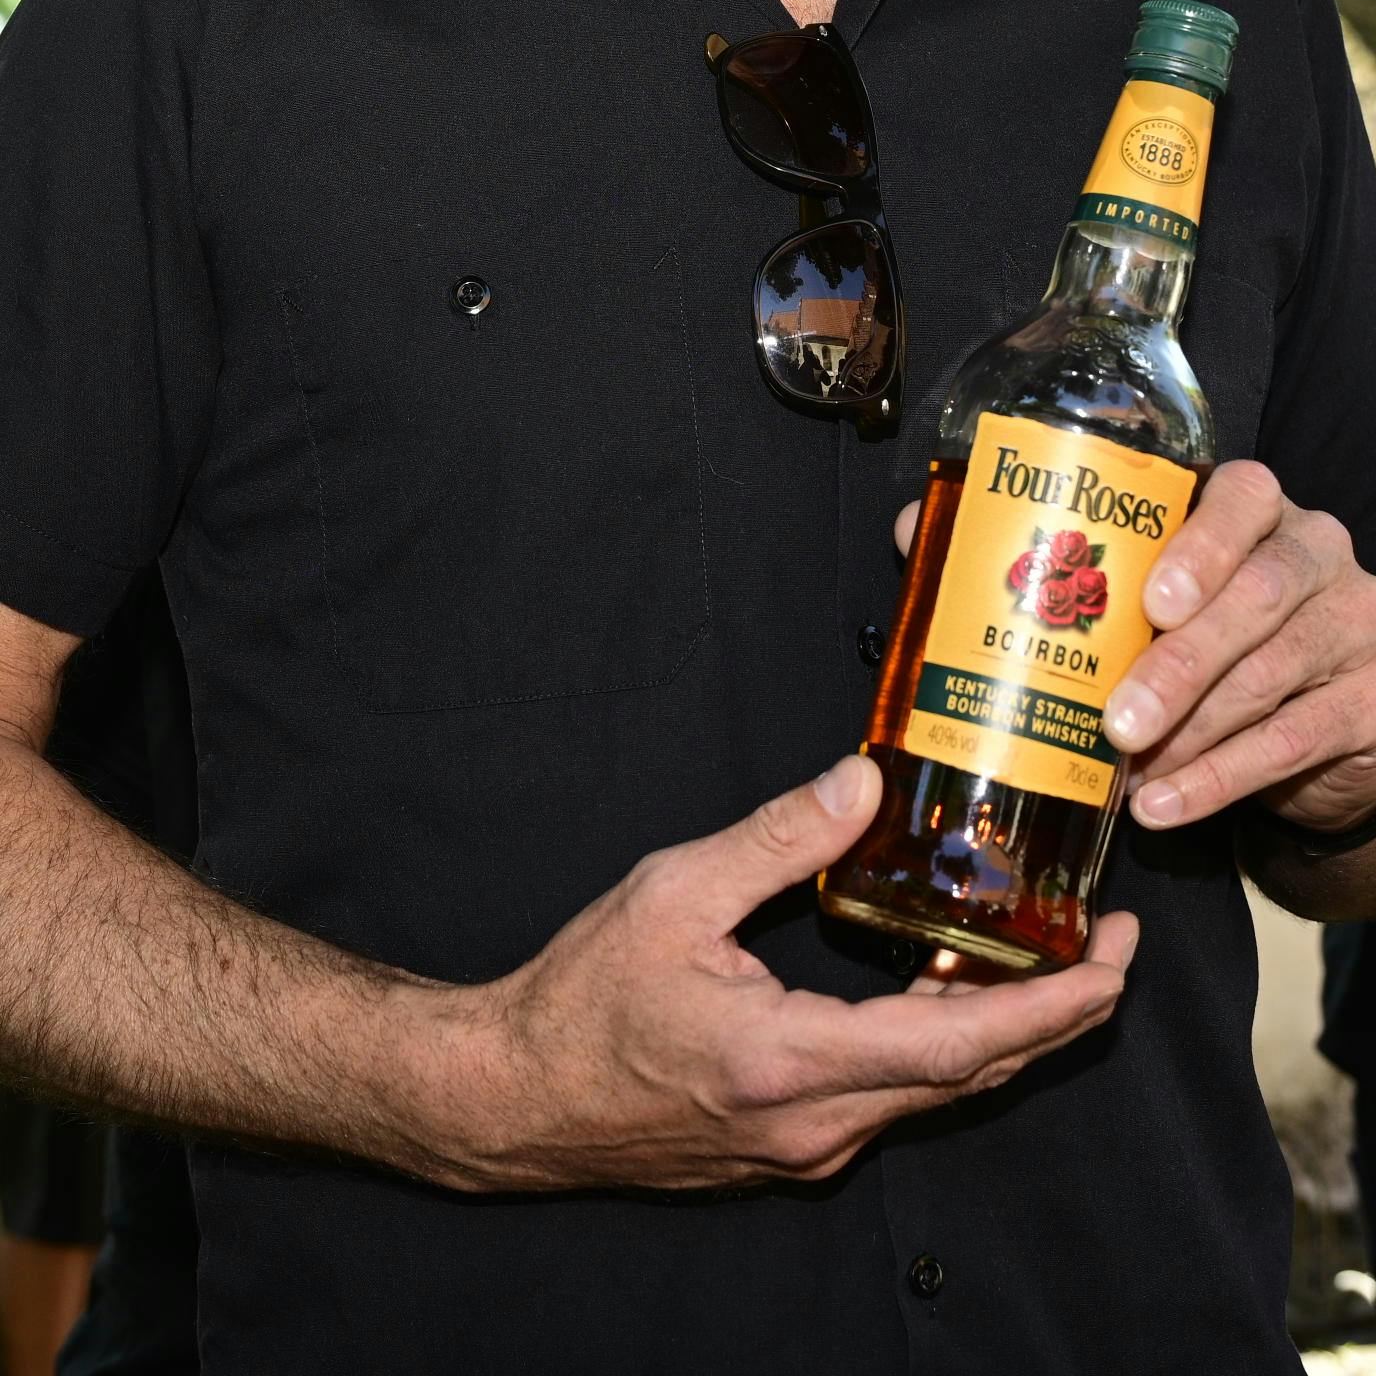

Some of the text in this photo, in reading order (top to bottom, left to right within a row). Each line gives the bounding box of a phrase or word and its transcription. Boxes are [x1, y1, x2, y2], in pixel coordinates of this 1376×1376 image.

[1140, 142, 1183, 171] 1888
[1141, 134, 1186, 153] ESTABLISHED
[1096, 201, 1190, 241] IMPORTED
[987, 447, 1168, 540] Four Roses
[928, 724, 959, 751] 40%
[1031, 717, 1098, 750] WHISKEY
